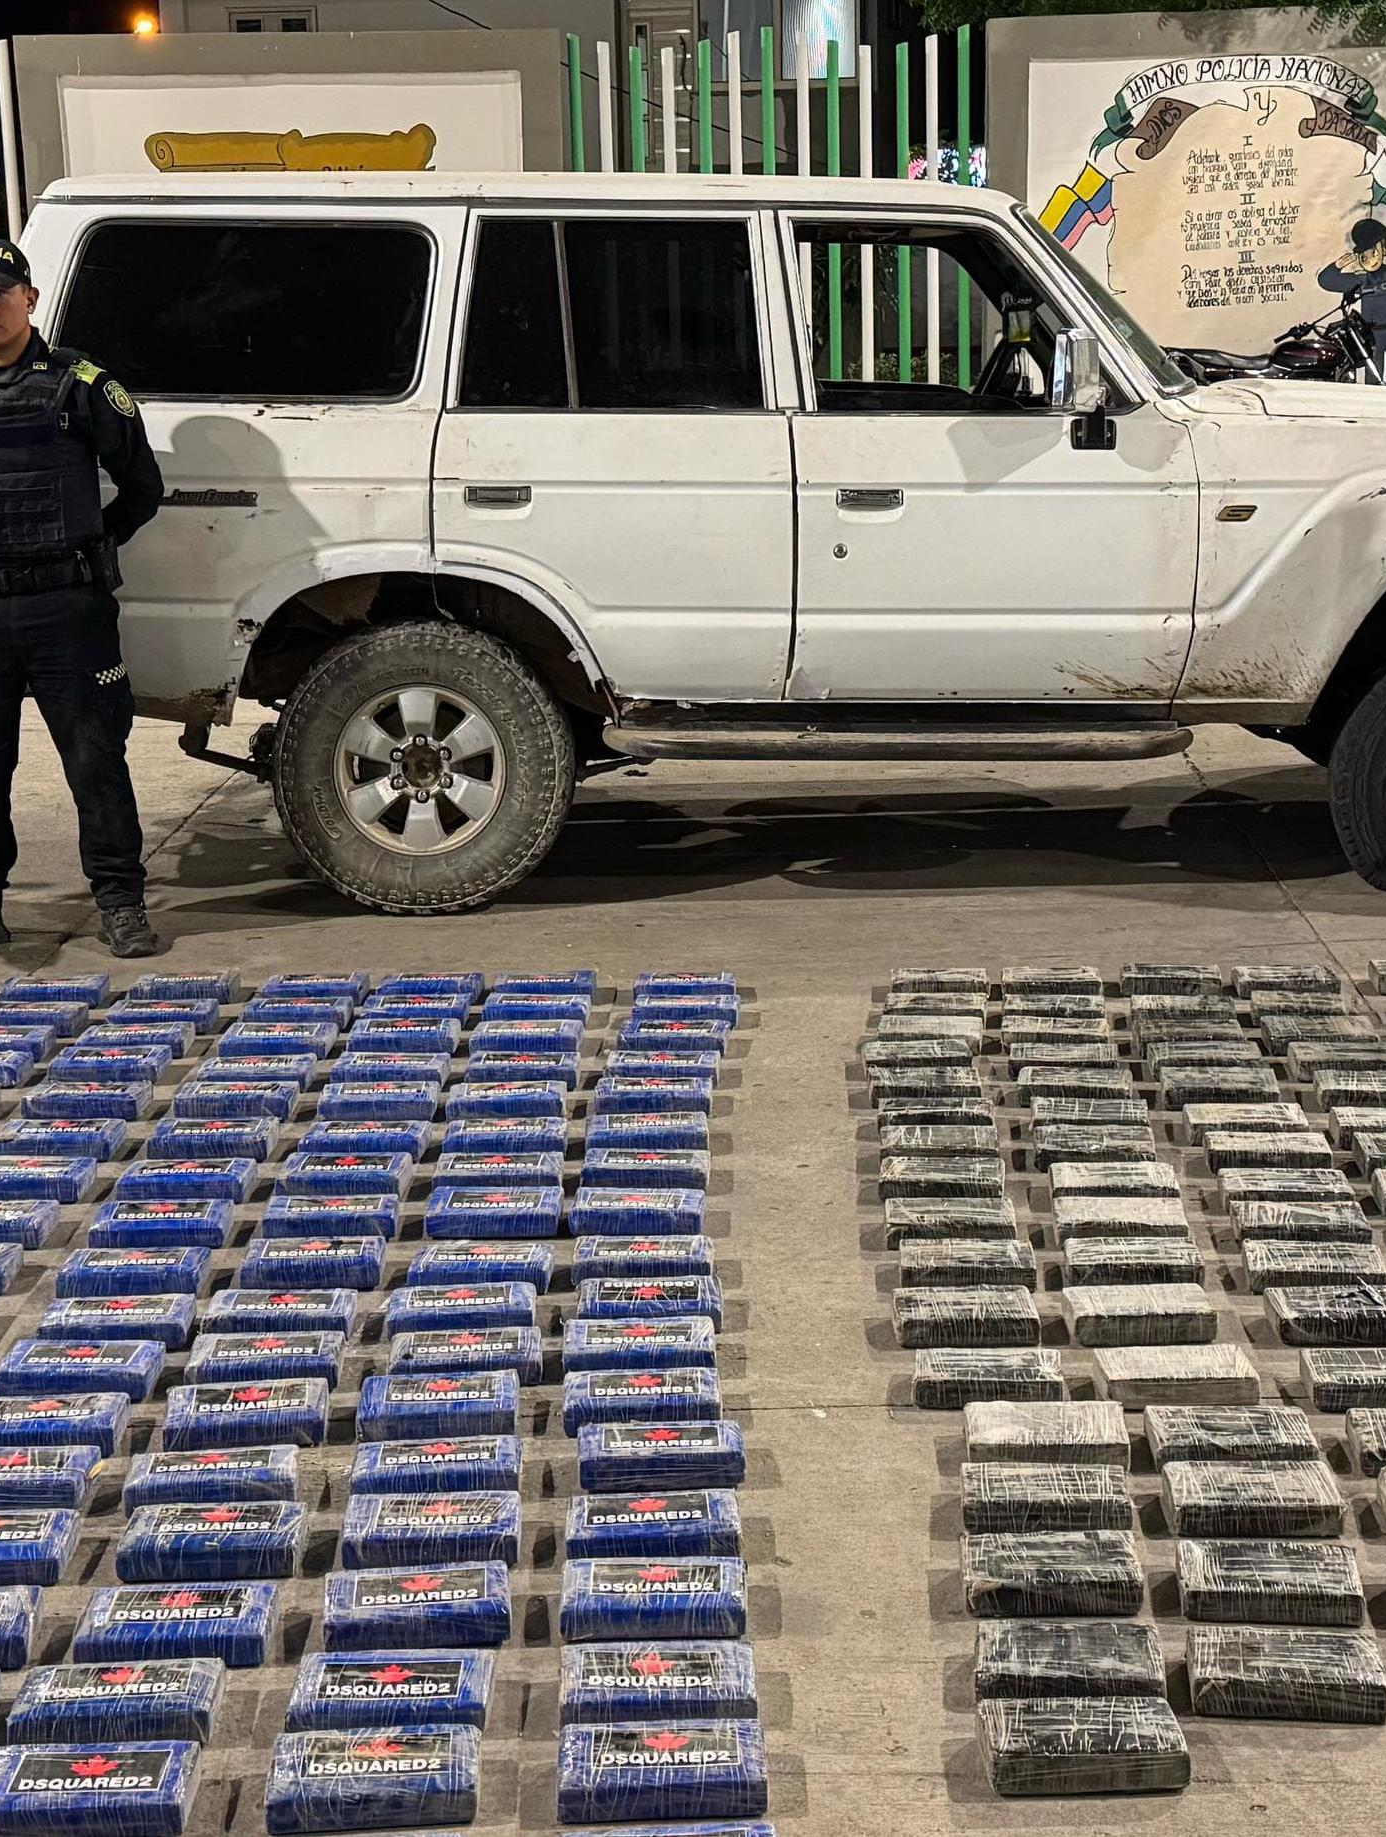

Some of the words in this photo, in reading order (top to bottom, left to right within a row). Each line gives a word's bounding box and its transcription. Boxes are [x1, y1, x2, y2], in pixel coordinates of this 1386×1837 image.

[1126, 63, 1189, 104] HIMNO
[1275, 57, 1369, 101] NACIONAL
[1147, 100, 1183, 140] DIOS
[1243, 135, 1253, 146] I
[1240, 193, 1256, 205] II
[1238, 250, 1255, 264] III
[87, 1258, 177, 1266] DSQUARED2
[235, 1303, 326, 1311] DSQUARED2
[414, 1298, 505, 1307] DSQUARED2
[69, 1308, 165, 1316] DSQUARED2
[591, 1336, 686, 1344] DSQUARED2
[217, 1348, 315, 1357] DSQUARED2
[417, 1343, 513, 1353] DSQUARED2
[28, 1356, 125, 1365] DSQUARED2
[391, 1392, 490, 1401] DSQUARED2
[595, 1386, 695, 1396] DSQUARED2
[199, 1400, 300, 1412] DSQUARED2
[609, 1438, 713, 1448] DSQUARED2
[385, 1453, 490, 1464] DSQUARED2
[156, 1461, 263, 1472] DSQUARED2
[383, 1514, 492, 1526] DSQUARED2
[593, 1511, 703, 1524] DSQUARED2
[159, 1522, 271, 1532] DSQUARED2
[599, 1582, 714, 1592] DSQUARED2
[362, 1589, 478, 1605] DSQUARED2
[114, 1607, 234, 1620] DSQUARED2
[588, 1675, 713, 1688] DSQUARED2
[53, 1683, 180, 1698] DSQUARED2
[326, 1683, 450, 1695] DSQUARED2
[601, 1751, 731, 1765] DSQUARED2
[309, 1758, 441, 1774] DSQUARED2
[18, 1776, 152, 1790] DSQUARED2
